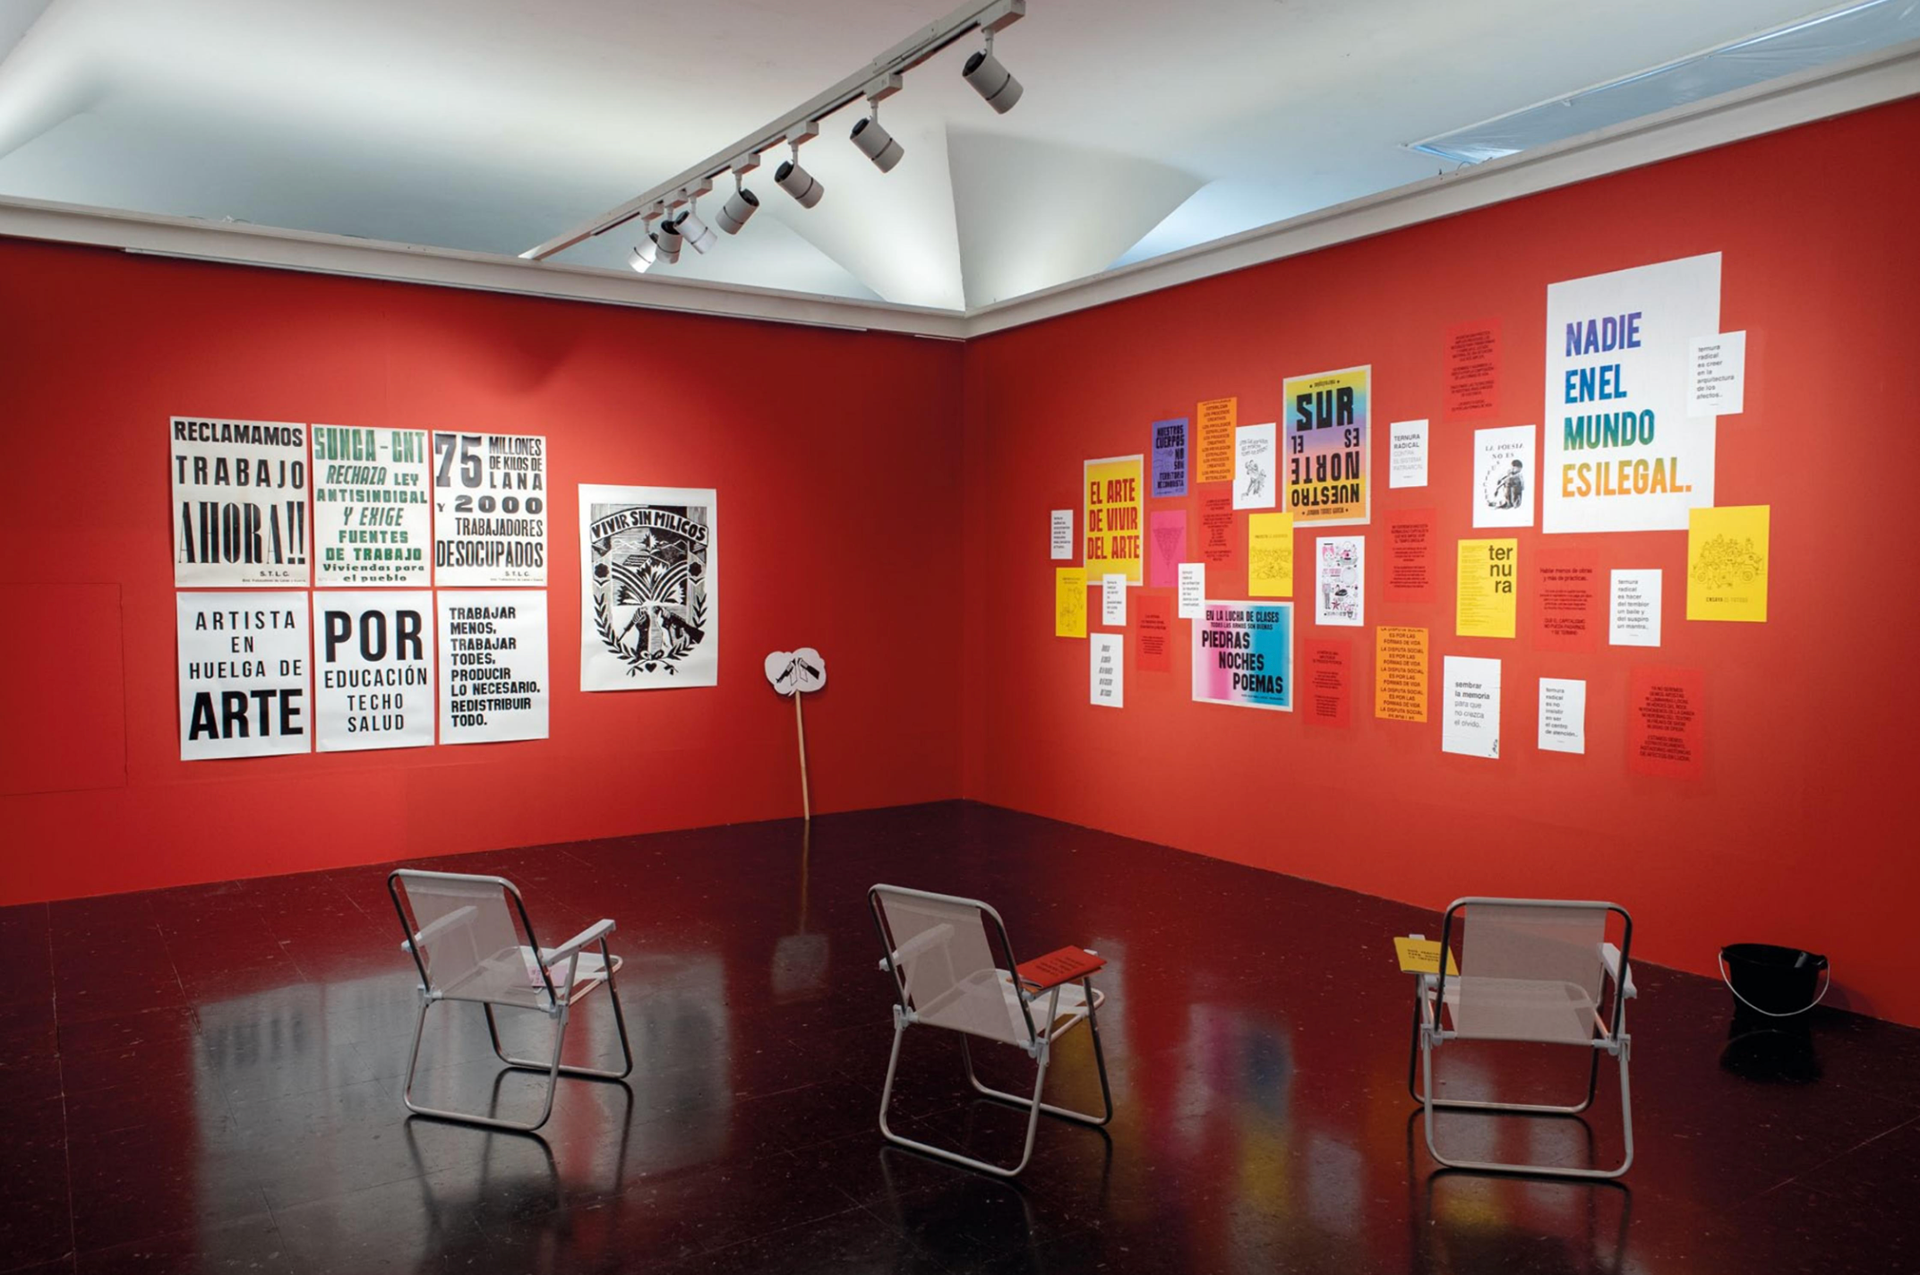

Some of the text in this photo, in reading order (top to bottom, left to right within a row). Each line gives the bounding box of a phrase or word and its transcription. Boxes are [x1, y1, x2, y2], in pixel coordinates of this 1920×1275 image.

[1565, 312, 1642, 357] NADIE
[1296, 387, 1353, 432] SUR
[174, 421, 303, 447] RECLAMAMOS
[1564, 409, 1655, 451] MUNDO
[489, 436, 542, 457] MILLONES
[436, 433, 482, 488] 75
[489, 457, 542, 472] DE KILOS DE
[1292, 451, 1360, 485] NORTE
[176, 455, 304, 489] TRABAJO
[326, 465, 419, 486] RECHAZA LEY
[490, 472, 543, 491] LANA
[317, 488, 428, 504] ANTISINDICAL
[1091, 478, 1135, 505] EL ARTE
[1292, 484, 1360, 507] NUESTRO
[437, 495, 543, 513] Y 2000
[343, 507, 404, 527] Y EXIGE
[591, 510, 706, 540] VIVIR SIN MILICOS
[1089, 507, 1138, 532] DE VIVIR
[179, 501, 306, 565] AHORA!!
[339, 530, 408, 544] FUENTES
[455, 518, 543, 538] TRABAJADORES
[326, 548, 422, 561] DE TRABAJO
[436, 540, 543, 568] DESOCUPADOS
[1087, 537, 1107, 560] DEL
[1111, 535, 1140, 559] ARTE
[1489, 545, 1513, 560] ter
[323, 563, 425, 573] Viviendas para
[343, 573, 407, 582] el pueblo
[1490, 564, 1512, 577] nu
[1495, 580, 1512, 593] ra
[195, 610, 296, 630] ARTISTA
[449, 607, 516, 620] TRABAJAR
[1206, 610, 1279, 623] EN LA LUCHA DE CLASES
[232, 636, 254, 653] EN
[324, 610, 423, 663] POR
[450, 638, 516, 651] TRABAJAR
[1202, 630, 1250, 649] PIEDRAS
[189, 659, 302, 679] HUELGA DE
[1219, 651, 1264, 671] NOCHES
[324, 664, 428, 689] EDUCACIÓN
[451, 668, 511, 682] PRODUCIR
[1233, 672, 1283, 694] POEMAS
[1455, 681, 1482, 689] sembrar
[452, 681, 540, 697] LO NECESARIO.
[347, 693, 403, 712] TECHO
[451, 698, 532, 713] REDISTRIBUIR
[188, 688, 303, 741] ARTE
[348, 714, 404, 733] SALUD
[451, 714, 487, 727] TODO.
[1464, 711, 1484, 719] crezca
